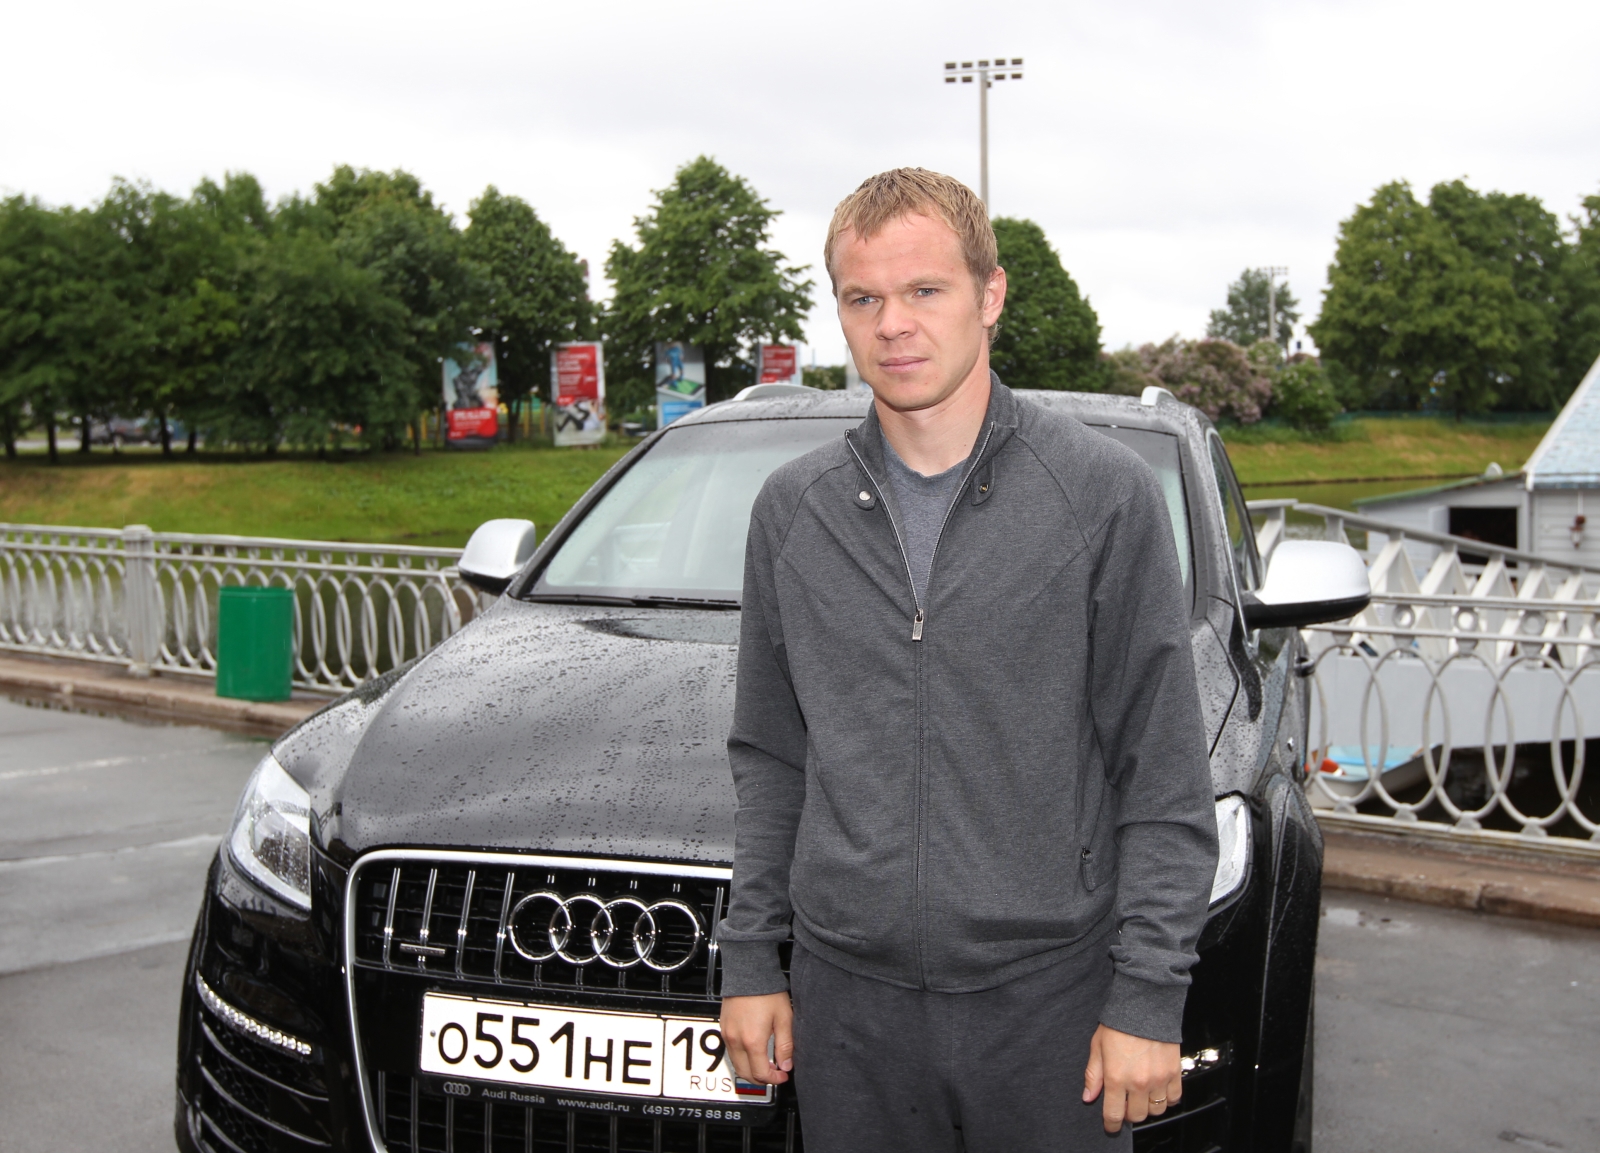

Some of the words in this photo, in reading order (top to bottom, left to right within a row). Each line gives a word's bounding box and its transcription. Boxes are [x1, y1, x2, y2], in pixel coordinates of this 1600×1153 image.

[672, 1027, 726, 1072] 19
[690, 1075, 732, 1093] RUS
[481, 1088, 507, 1099] Audi
[510, 1092, 545, 1104] Russia
[557, 1097, 630, 1112] www.audi.ru
[642, 1104, 675, 1116] (495)
[678, 1107, 702, 1118] 775
[705, 1109, 722, 1119] 88
[725, 1111, 741, 1120] 88
